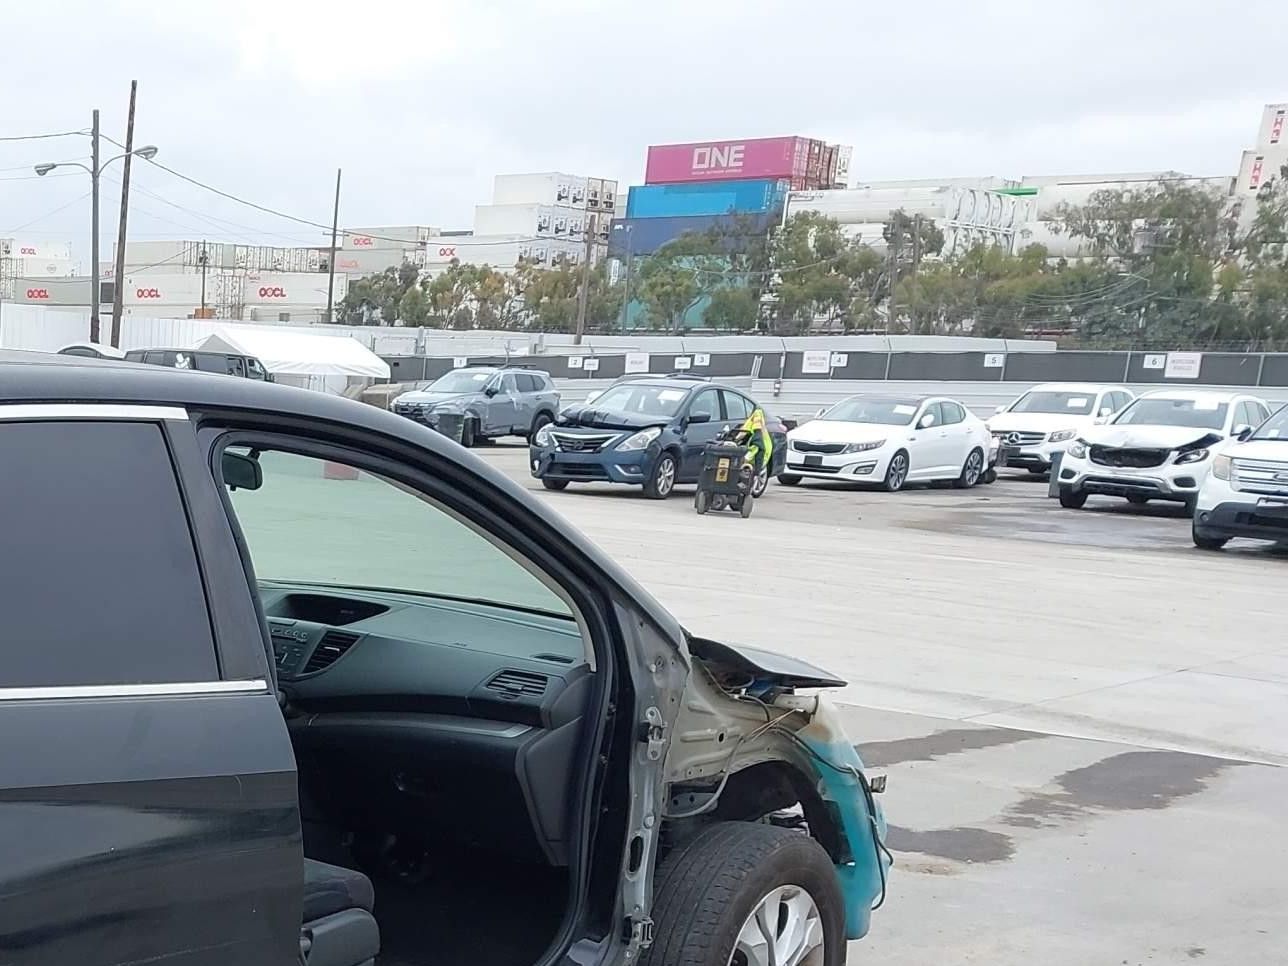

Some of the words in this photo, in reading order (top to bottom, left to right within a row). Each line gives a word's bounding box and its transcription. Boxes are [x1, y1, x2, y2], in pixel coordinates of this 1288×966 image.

[693, 145, 745, 168] ONE
[27, 289, 48, 298] OOCL
[137, 288, 160, 298] OOCL
[259, 287, 286, 297] OOCL
